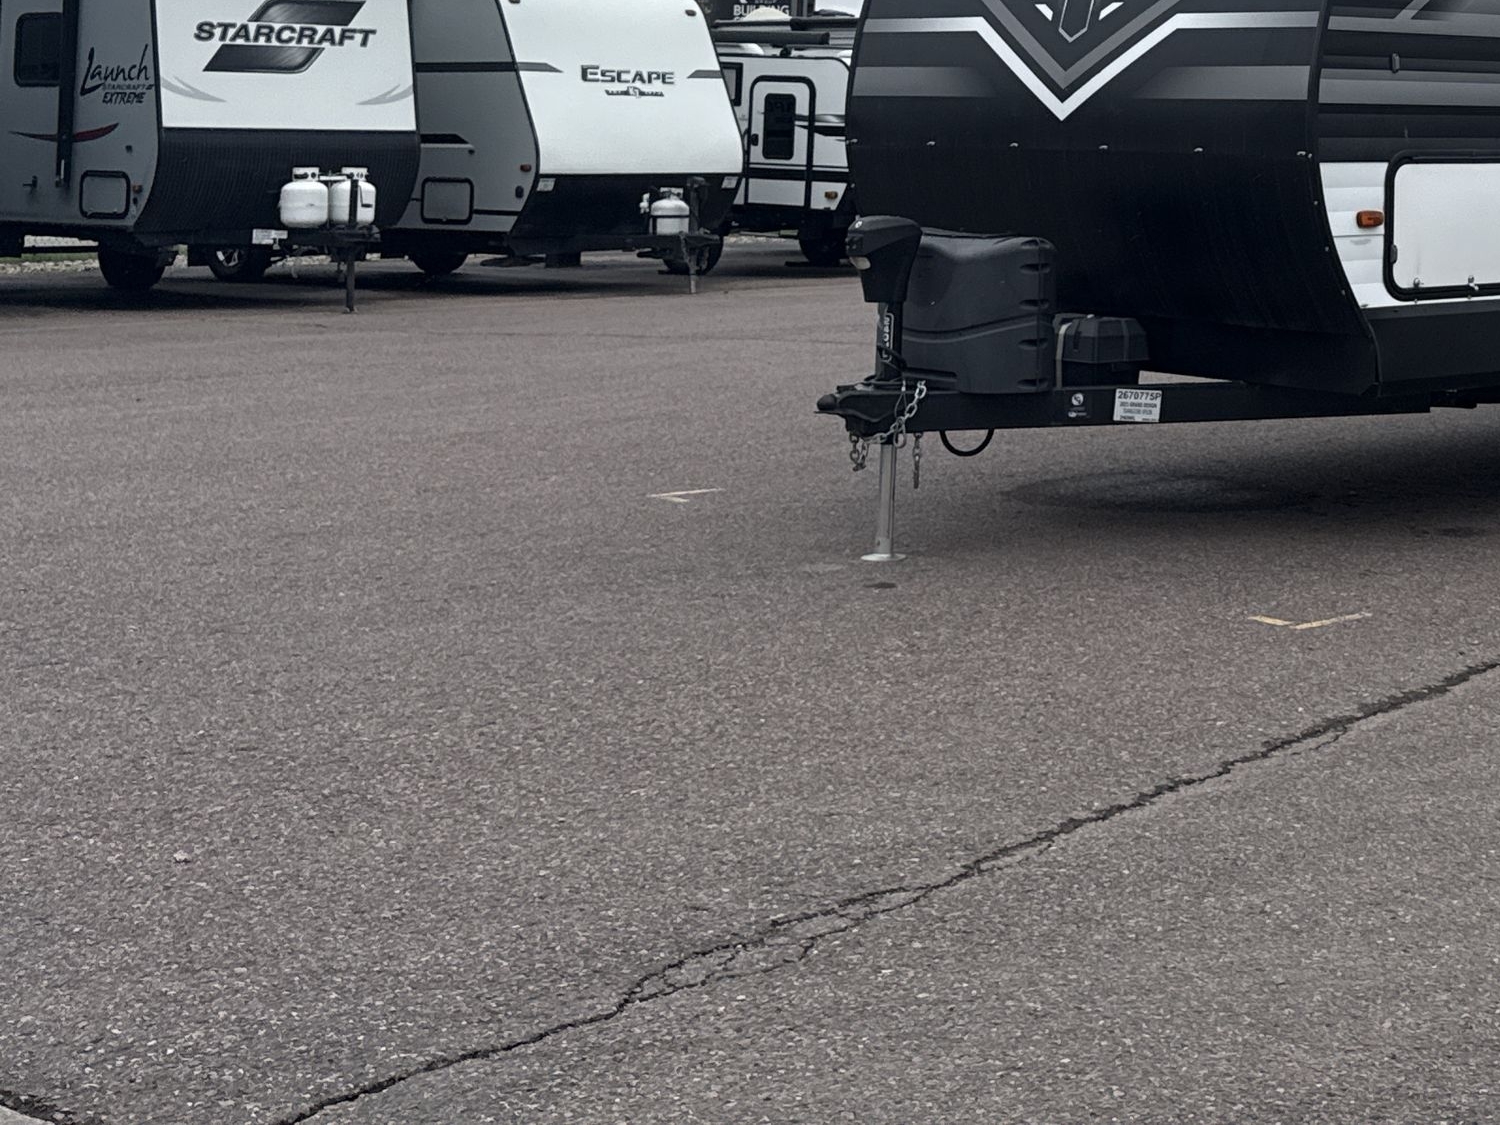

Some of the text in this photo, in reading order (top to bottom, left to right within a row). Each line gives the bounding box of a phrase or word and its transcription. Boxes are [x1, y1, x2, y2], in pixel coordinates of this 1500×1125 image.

[193, 21, 377, 47] STARCRAFT
[80, 43, 150, 96] Launch
[101, 91, 146, 105] EXTREME
